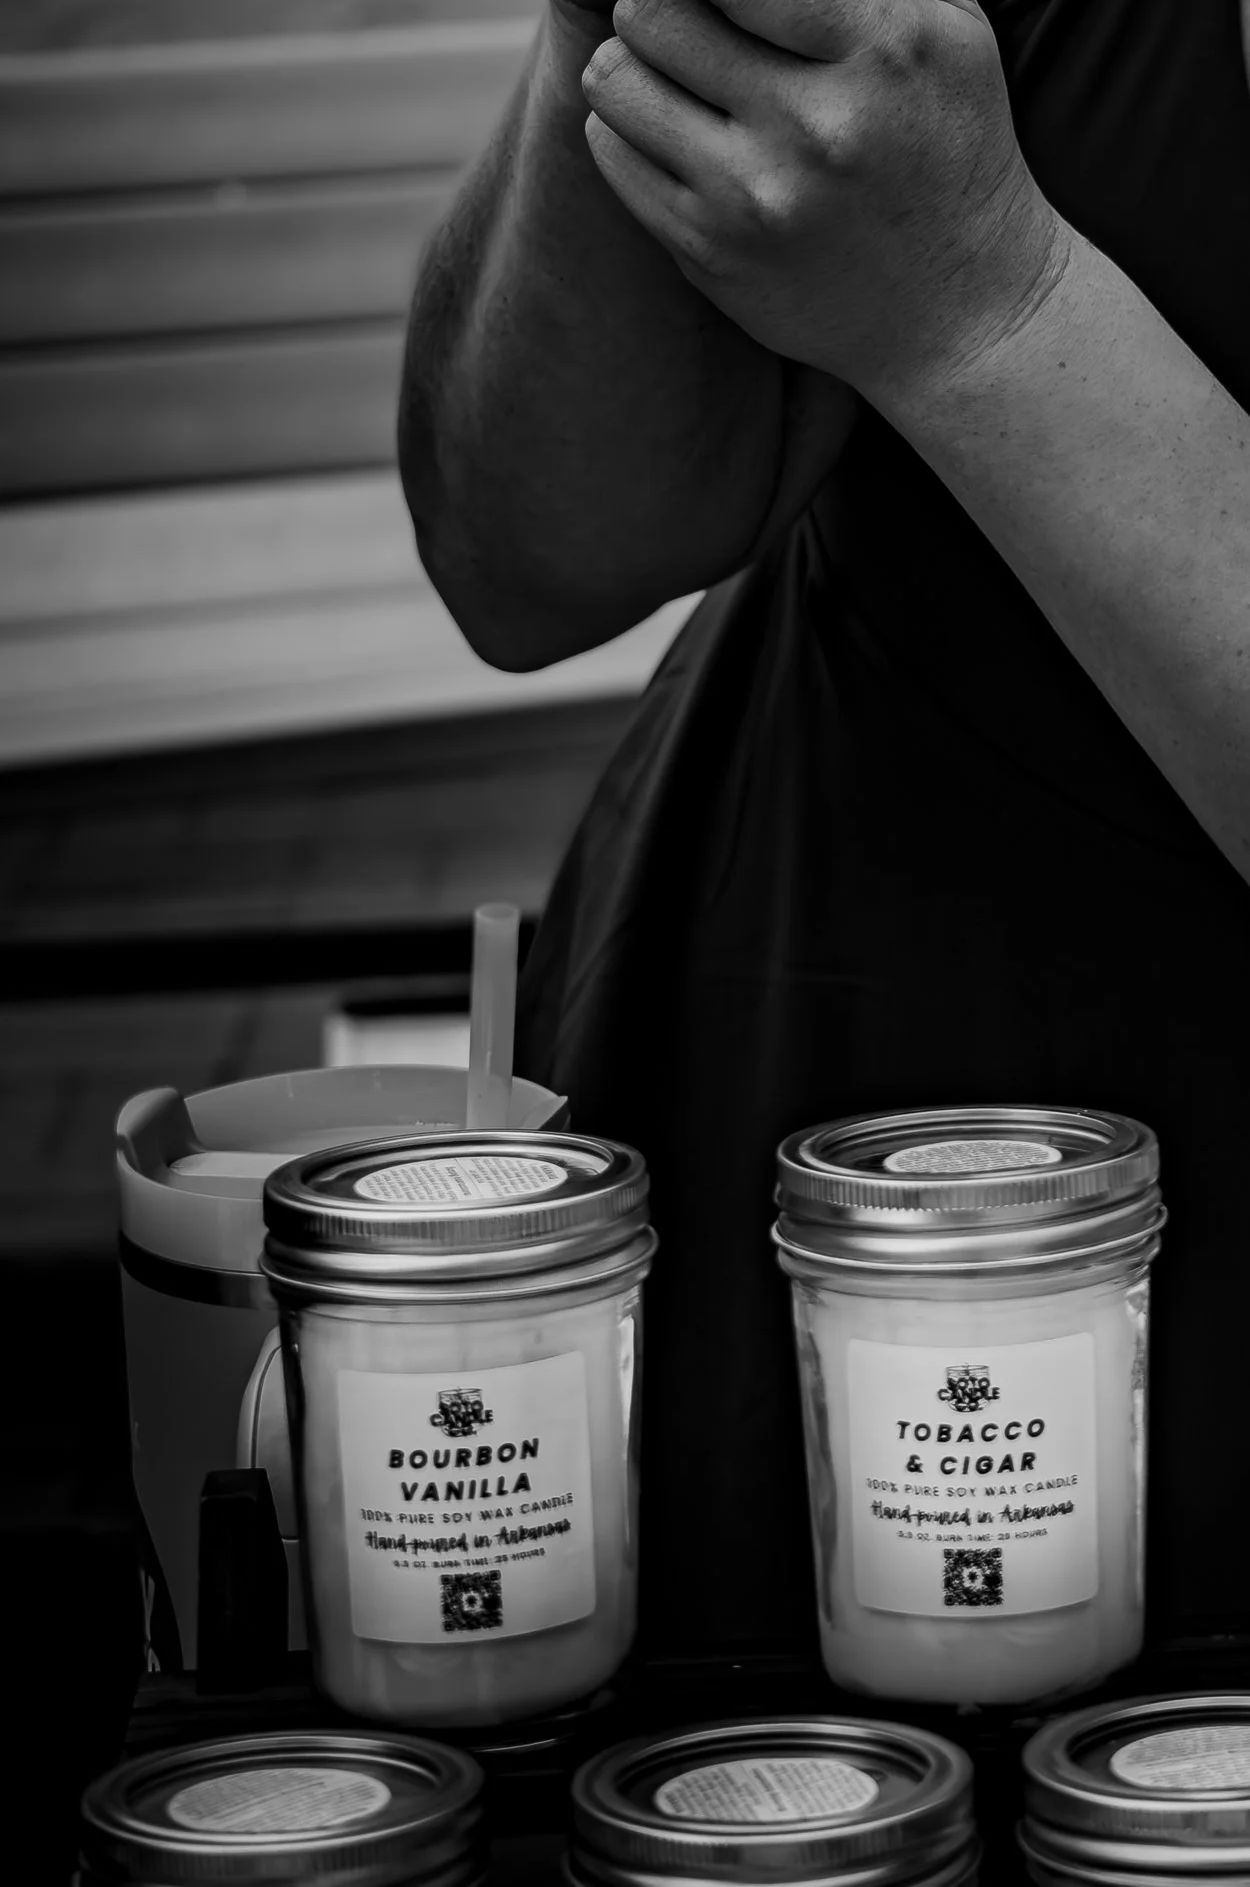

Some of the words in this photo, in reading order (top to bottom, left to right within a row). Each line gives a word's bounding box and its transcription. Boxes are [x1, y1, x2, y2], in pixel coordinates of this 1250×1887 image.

[896, 1418, 1045, 1443] TOBACCO
[389, 1438, 540, 1469] BOURBON
[906, 1454, 923, 1473] &
[940, 1451, 1037, 1475] CIGAR
[400, 1473, 532, 1501] VANILLA
